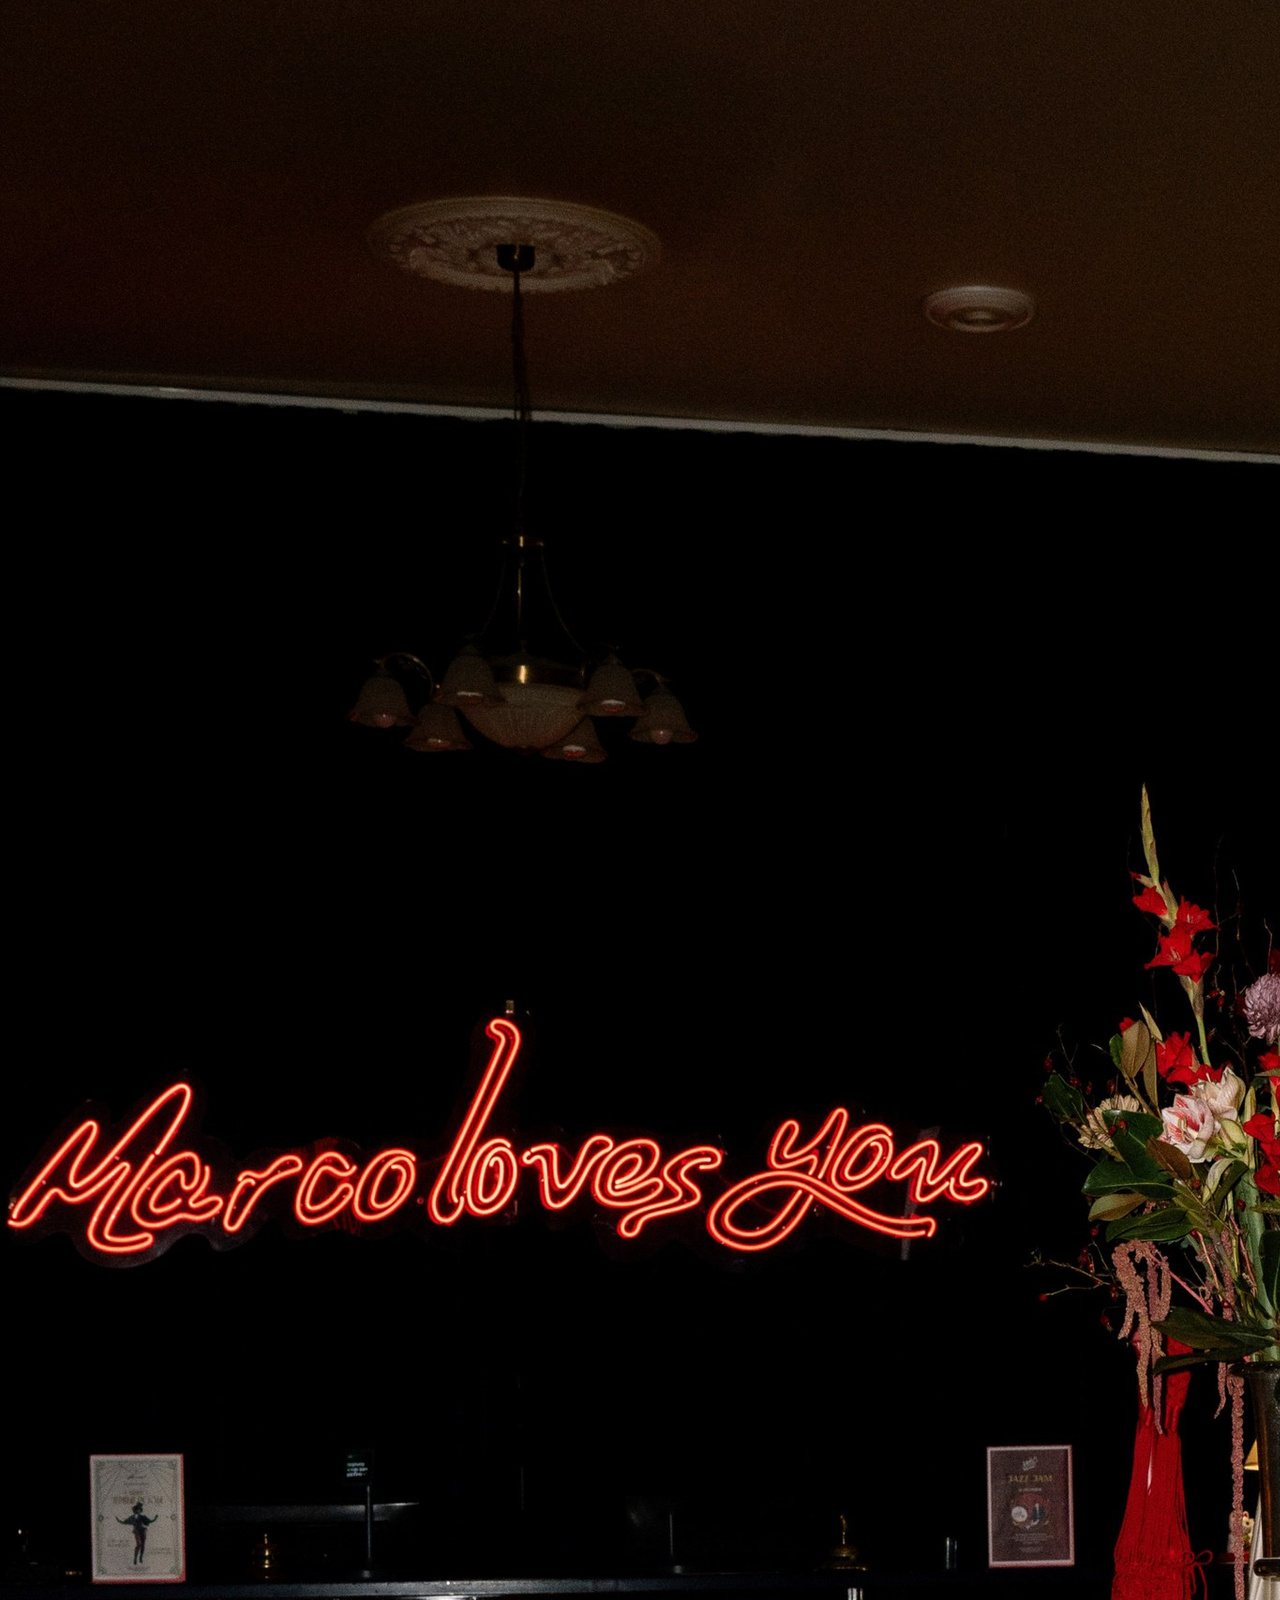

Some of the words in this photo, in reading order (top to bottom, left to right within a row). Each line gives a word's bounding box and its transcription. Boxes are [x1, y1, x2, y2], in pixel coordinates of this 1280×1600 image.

[8, 1081, 417, 1254] Marco
[428, 1017, 724, 1239] loves
[706, 1107, 992, 1252] you
